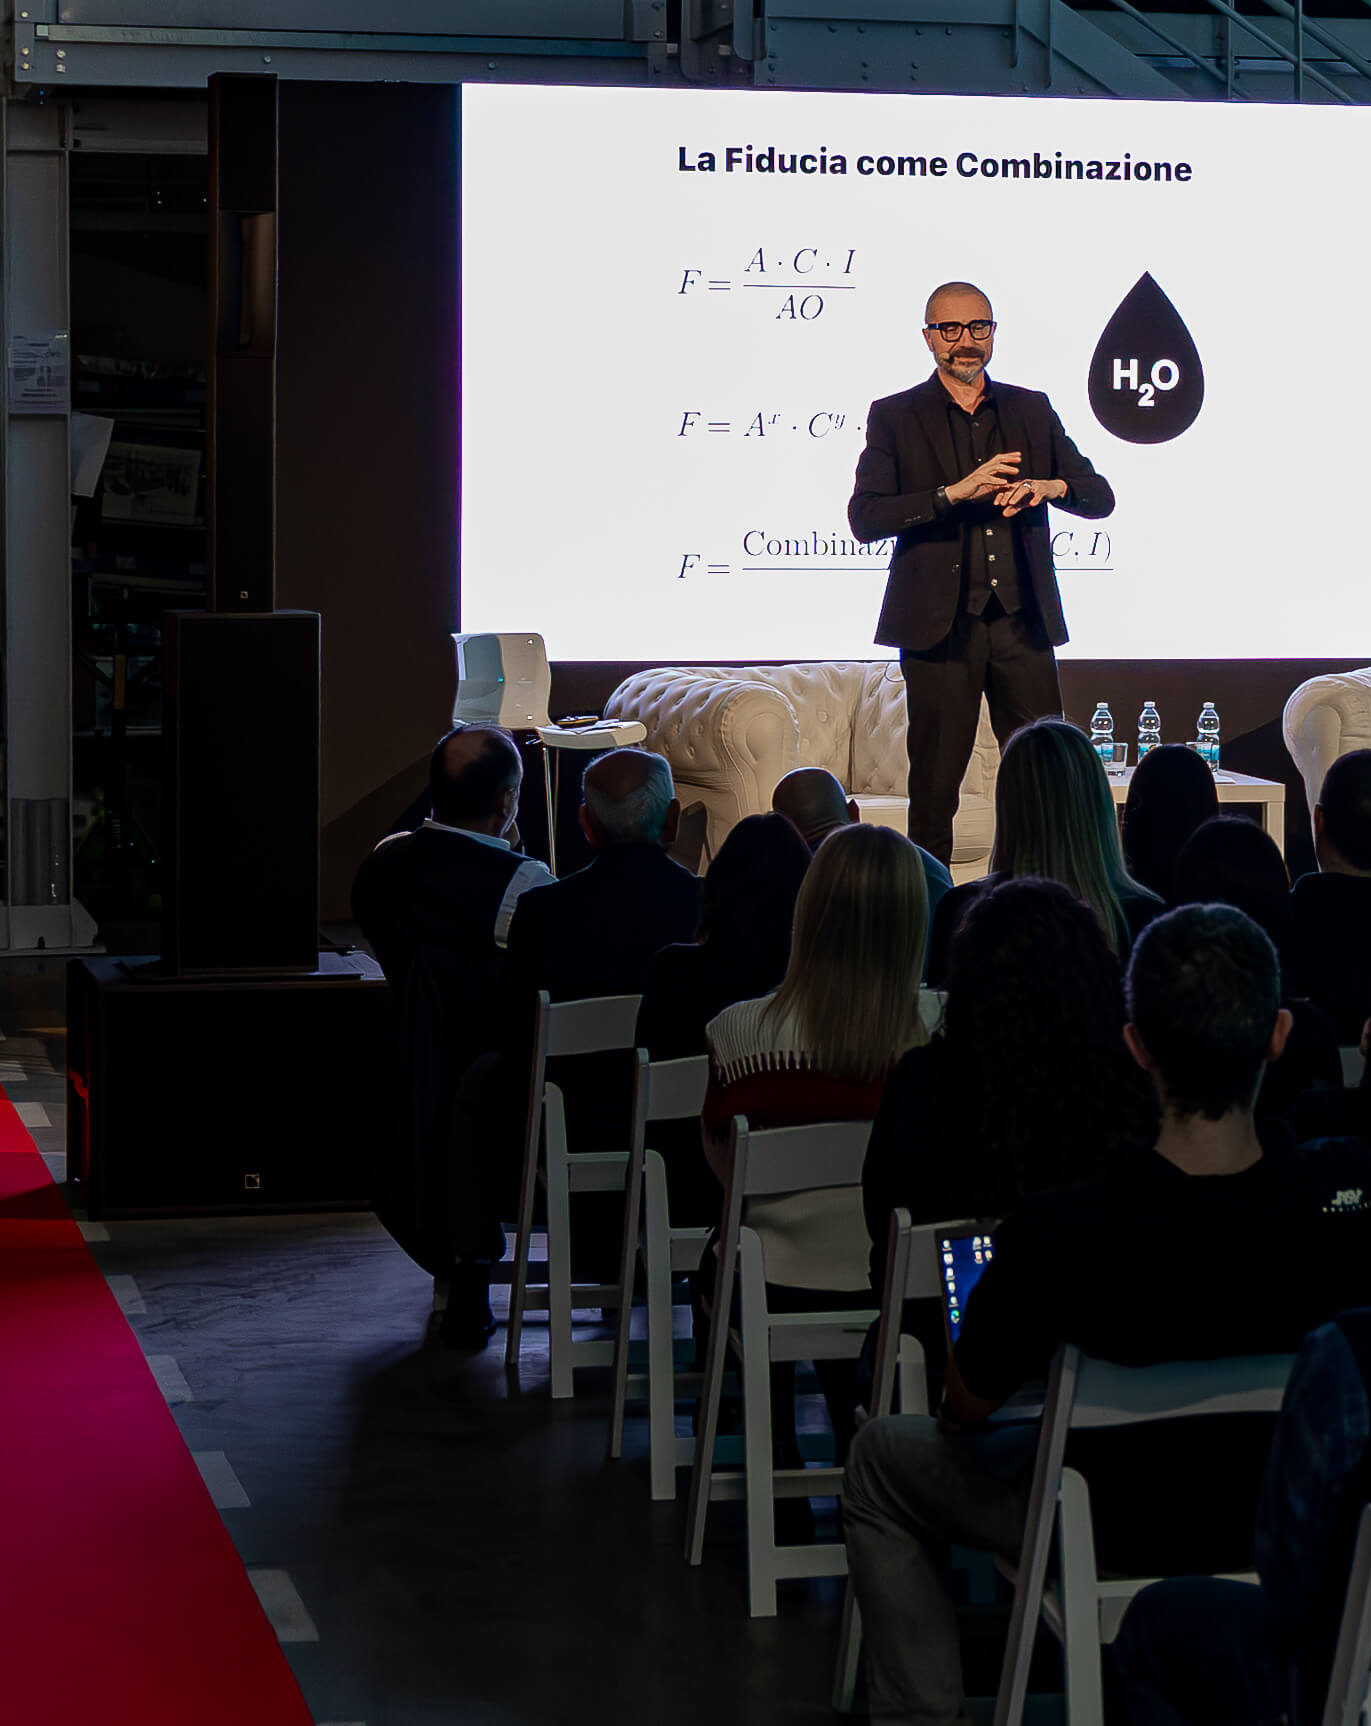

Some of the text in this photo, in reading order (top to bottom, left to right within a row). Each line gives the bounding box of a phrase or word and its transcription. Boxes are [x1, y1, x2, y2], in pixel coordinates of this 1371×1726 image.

[678, 144, 1193, 182] La Fiducia come Combinazione
[775, 294, 824, 321] AO
